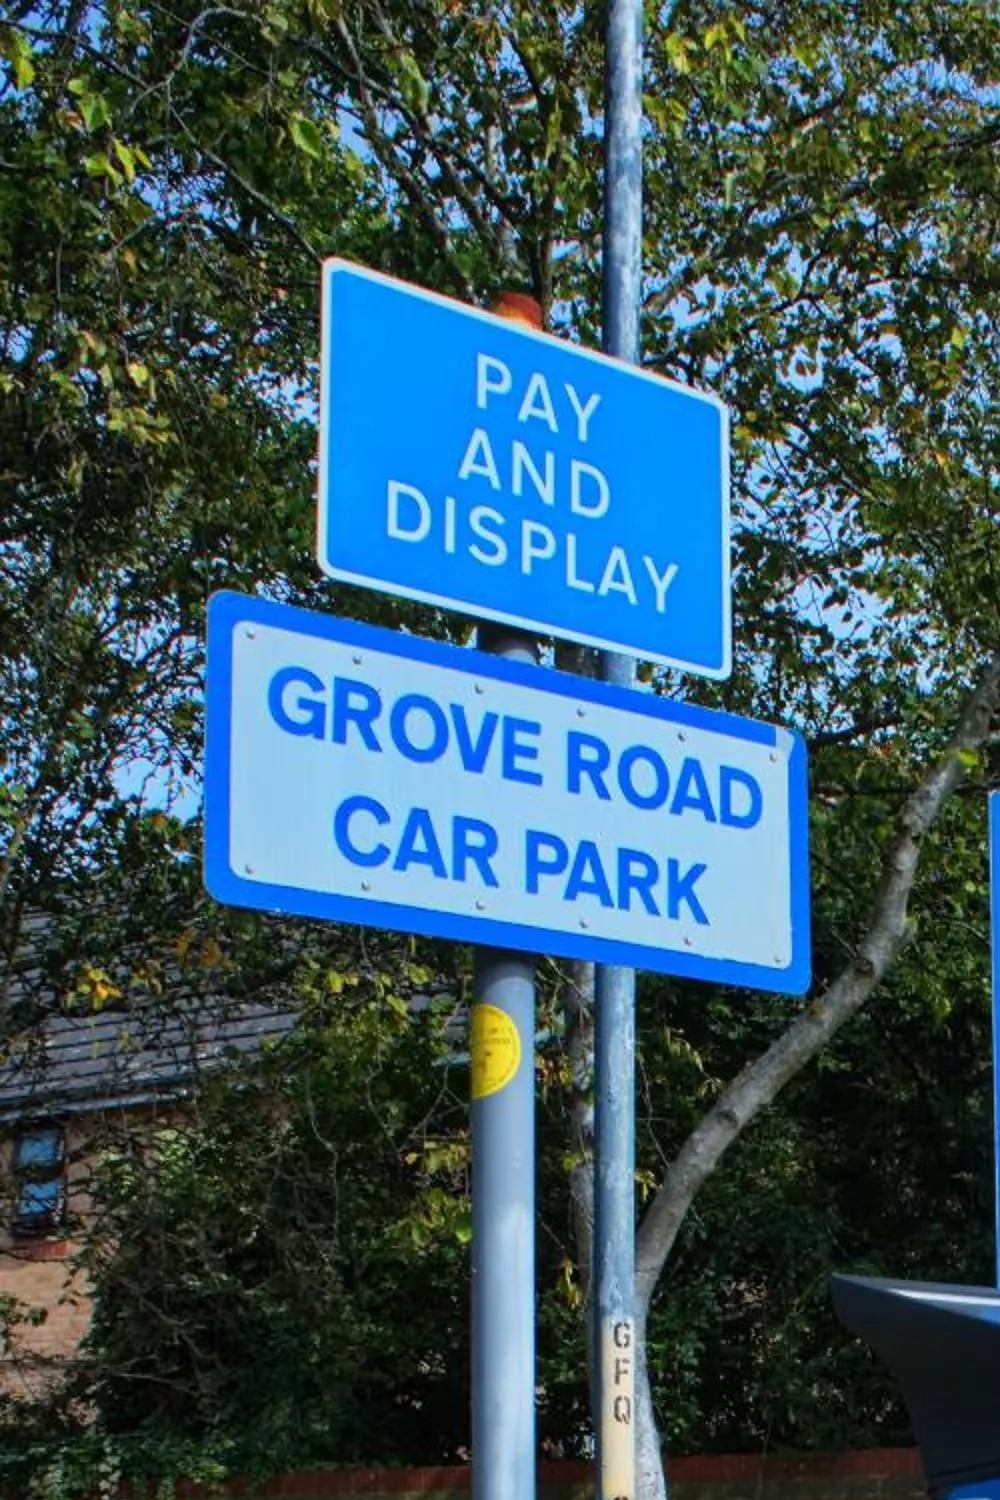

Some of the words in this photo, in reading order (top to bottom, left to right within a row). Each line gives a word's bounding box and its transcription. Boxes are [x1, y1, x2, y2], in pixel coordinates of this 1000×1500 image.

[476, 353, 602, 442] PAY
[459, 428, 610, 519] AND
[387, 479, 679, 614] DISPLAY
[266, 664, 543, 786] GROVE
[566, 731, 763, 830] ROAD
[333, 795, 499, 888] CAR
[524, 829, 711, 926] PARK
